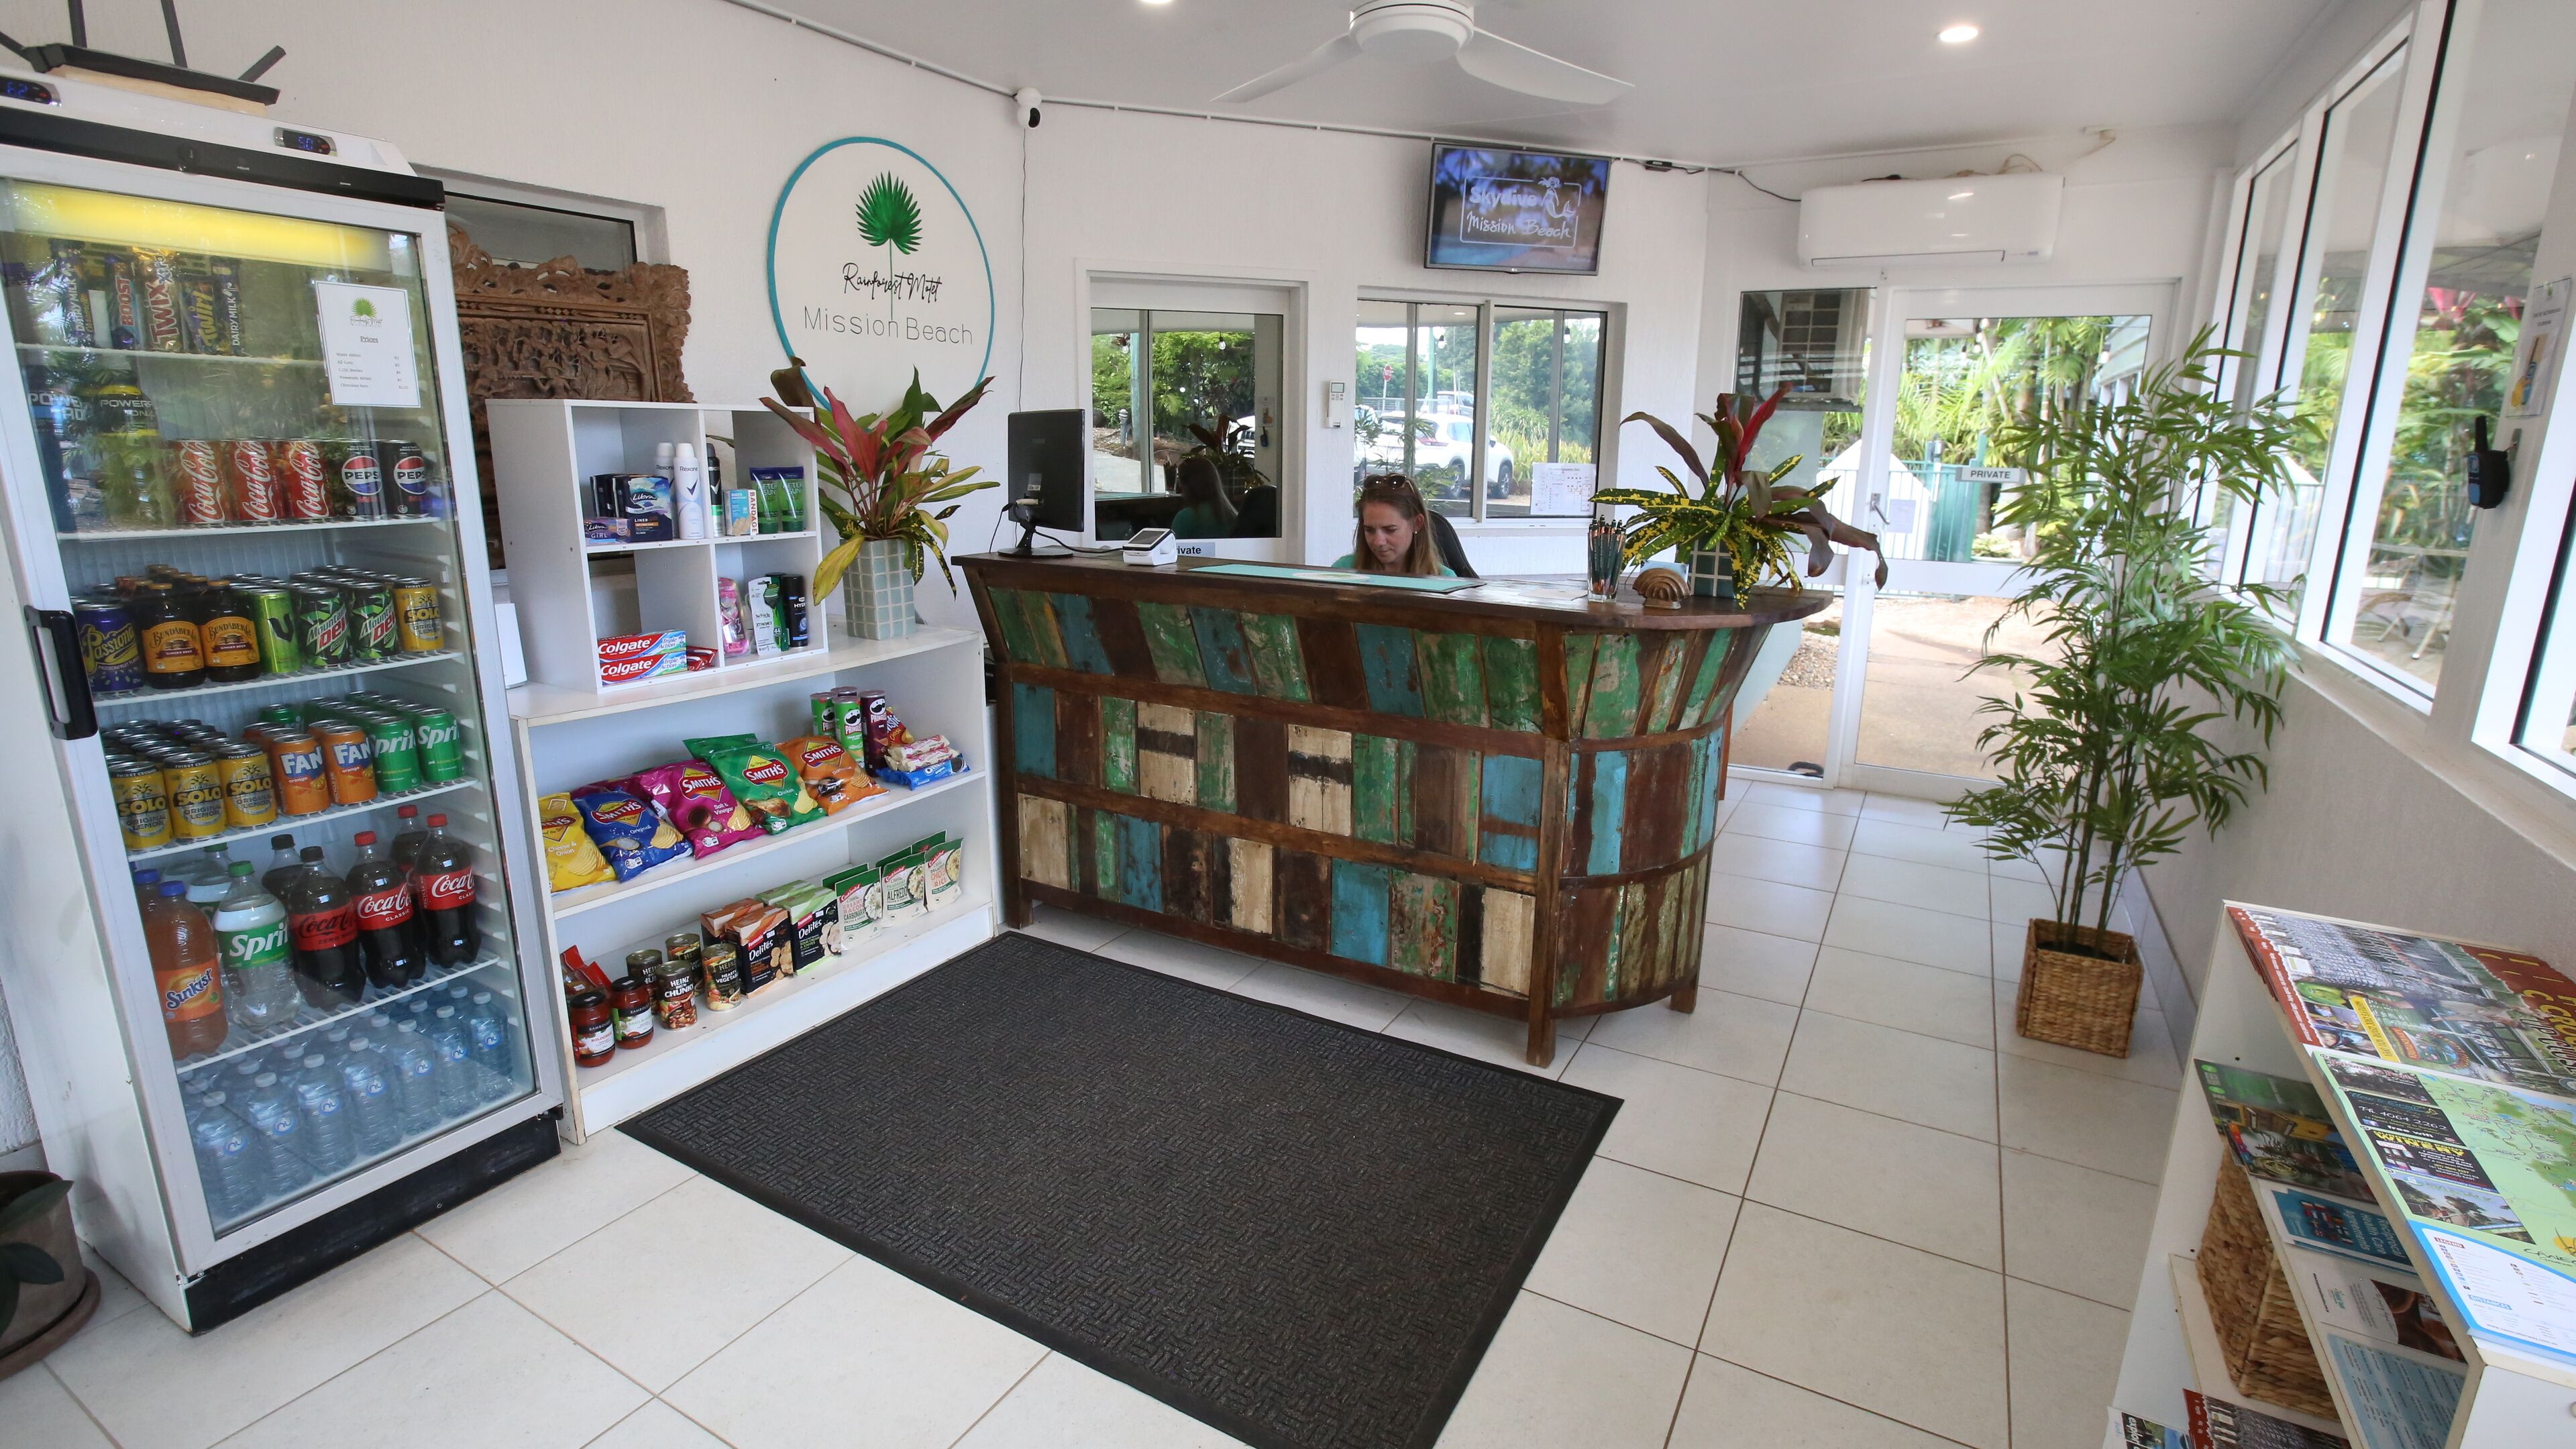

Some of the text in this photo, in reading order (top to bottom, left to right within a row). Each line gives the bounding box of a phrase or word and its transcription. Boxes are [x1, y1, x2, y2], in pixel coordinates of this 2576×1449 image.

[1466, 211, 1571, 238] Mission Beach
[843, 262, 943, 303] Rainforest Motel
[115, 275, 134, 327] BOOST
[146, 282, 180, 345] TWIX
[227, 297, 240, 346] DAIRY MILK
[804, 305, 973, 345] Mission Beach
[1970, 470, 2010, 478] PRIVATE
[633, 493, 657, 501] Libra
[749, 492, 757, 533] BANDAGE
[1177, 546, 1201, 554] ivate
[268, 612, 294, 642] V
[599, 638, 651, 655] Colgate
[600, 659, 653, 676] Colgate
[280, 746, 324, 775] FAN
[333, 739, 370, 765] FAN
[805, 745, 841, 763] SMITH'S
[747, 763, 785, 780] SMITH'S
[230, 777, 272, 794] SOLO
[682, 775, 721, 793] SMITH'S
[178, 788, 221, 805] SOLO
[119, 798, 166, 816] SOLO
[191, 810, 221, 819] LEMON
[597, 802, 641, 820] SMITH'S
[714, 807, 734, 815] Vinegar
[630, 825, 652, 835] Original
[548, 844, 570, 852] Cheese
[555, 848, 575, 857] Onion
[887, 886, 907, 900] ALFREDO
[385, 909, 410, 922] CLASSIC
[718, 960, 736, 971] HEINZ
[166, 968, 213, 1010] Sunkist
[670, 976, 690, 987] HEINZ
[665, 983, 694, 998] CHUNKY
[2380, 1111, 2410, 1122] 4064
[2413, 1119, 2448, 1131] 2262
[2387, 1125, 2434, 1138] free wifi
[2379, 1218, 2407, 1258] Reciprocal
